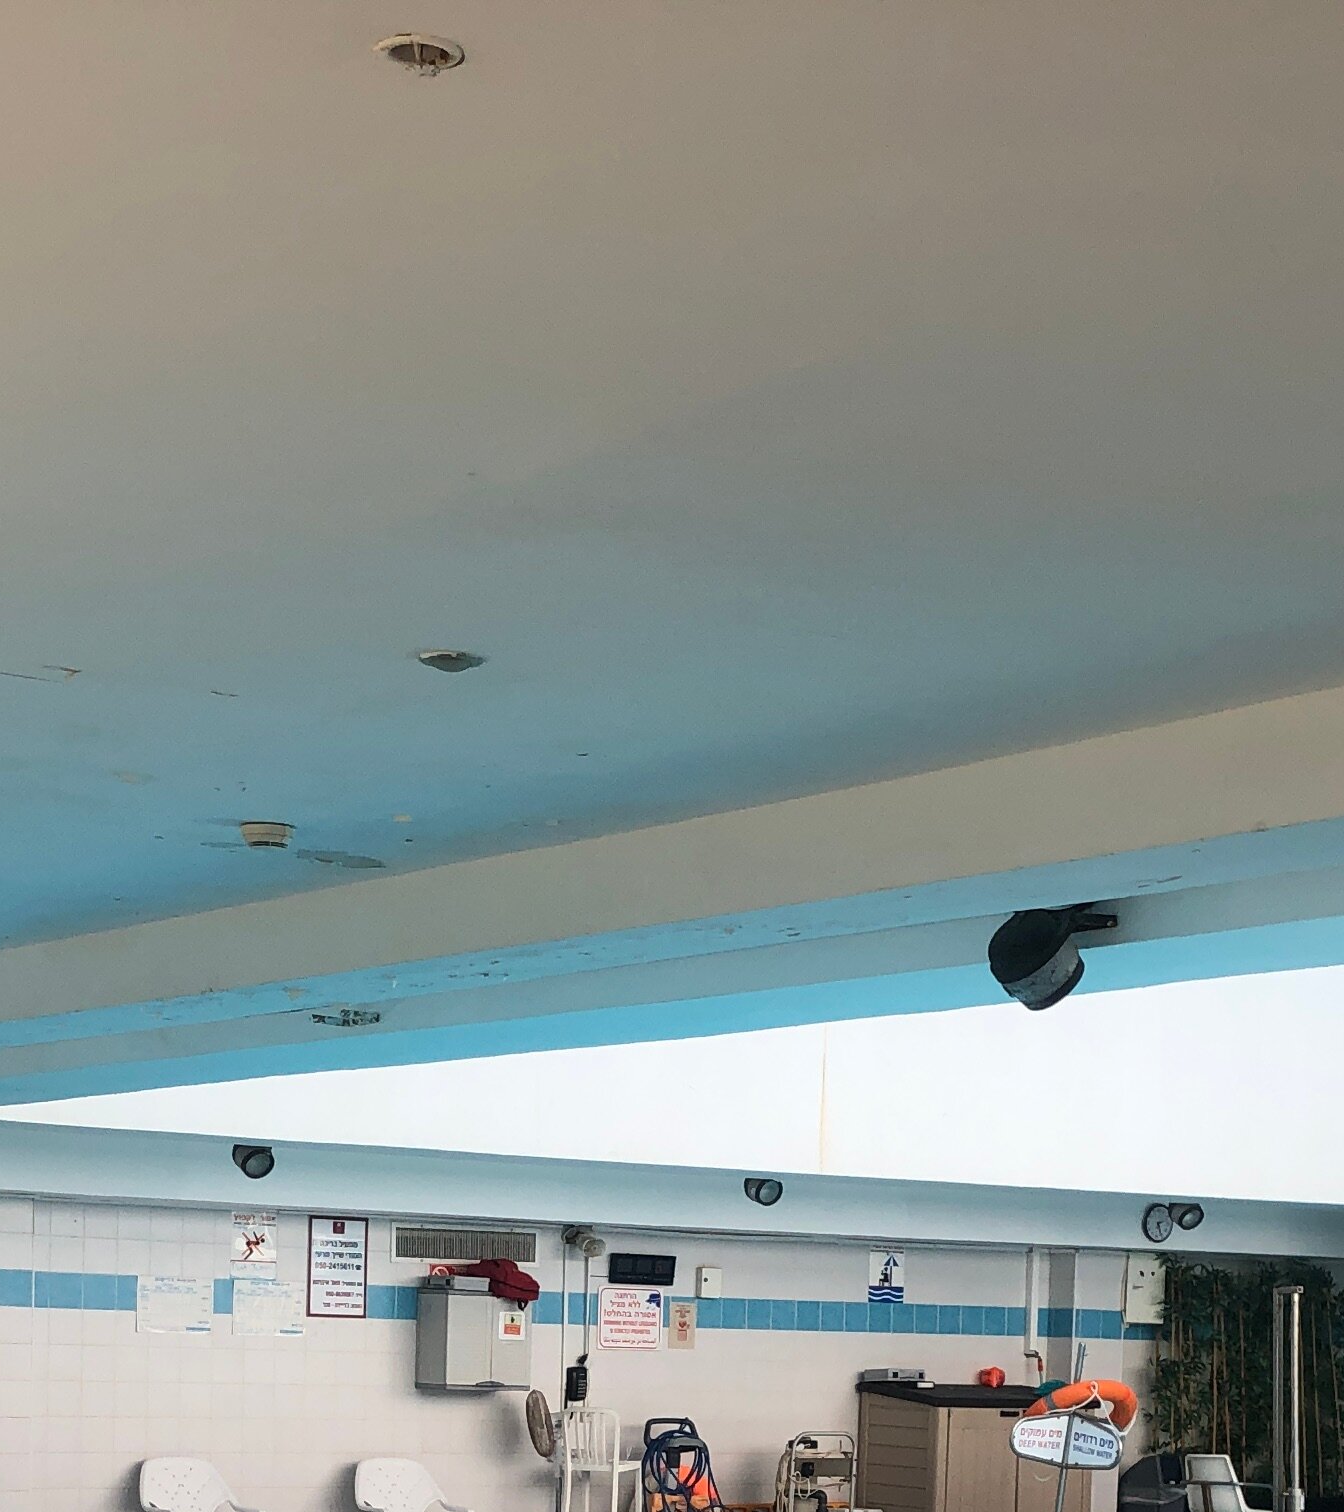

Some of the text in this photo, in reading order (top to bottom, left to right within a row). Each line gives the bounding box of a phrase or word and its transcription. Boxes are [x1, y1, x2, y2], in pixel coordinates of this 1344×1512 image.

[609, 1300, 641, 1308] ללא מציל
[1020, 1427, 1063, 1439] מים עמוקים
[1018, 1439, 1061, 1450] DEEP WATER
[1073, 1431, 1115, 1450] מים רדודים
[1072, 1443, 1113, 1460] SHALLOW WATER
